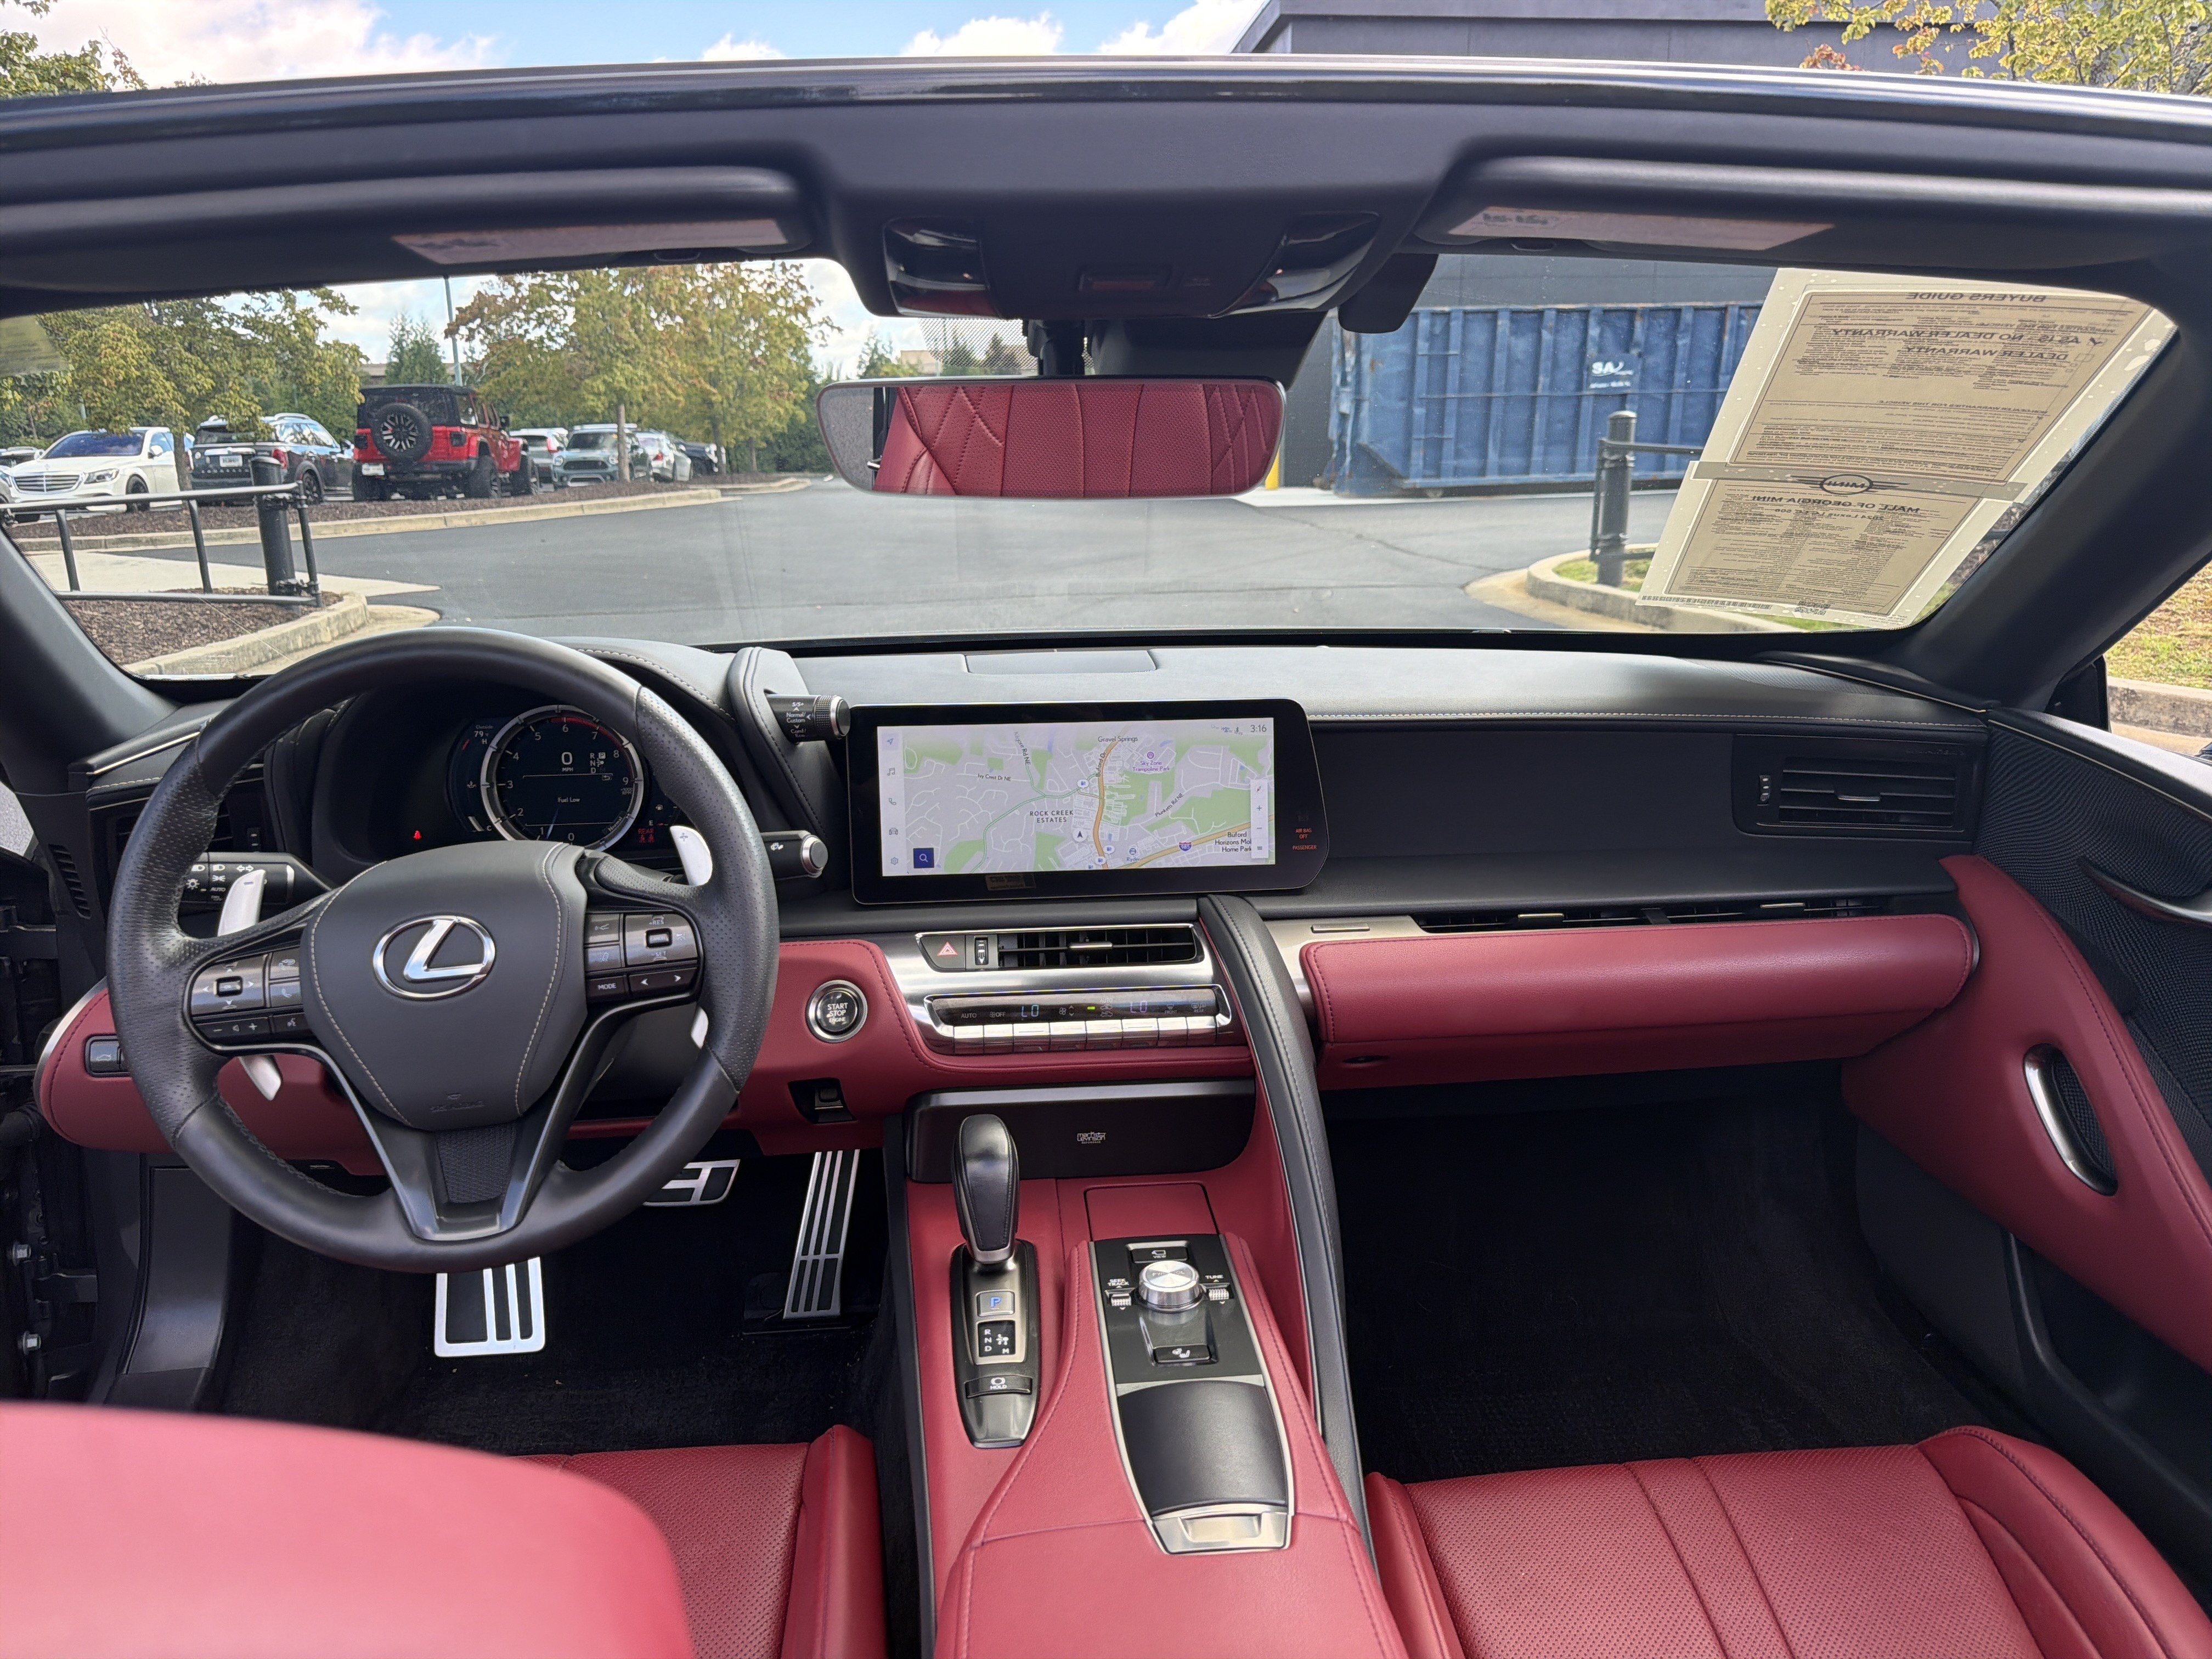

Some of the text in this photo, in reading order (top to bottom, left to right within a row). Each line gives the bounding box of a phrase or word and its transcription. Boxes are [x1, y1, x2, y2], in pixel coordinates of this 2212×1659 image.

[562, 724, 569, 732] 6
[1250, 724, 1267, 732] 3:16
[535, 732, 541, 741] 5
[591, 731, 597, 740] 7
[512, 752, 519, 761] 4
[613, 750, 619, 758] 8
[1022, 748, 1029, 757] Rd
[561, 752, 573, 765] 0
[1024, 757, 1031, 766] NE
[507, 780, 514, 789] 3
[623, 777, 629, 785] 9
[518, 808, 524, 816] 2
[1155, 802, 1173, 817] Plunketts
[1171, 798, 1179, 806] Rd
[540, 827, 544, 835] 1
[568, 832, 575, 842] 0
[827, 1002, 848, 1011] START
[1022, 1005, 1039, 1018] LO
[1130, 1000, 1148, 1014] LO
[991, 1297, 1001, 1308] P
